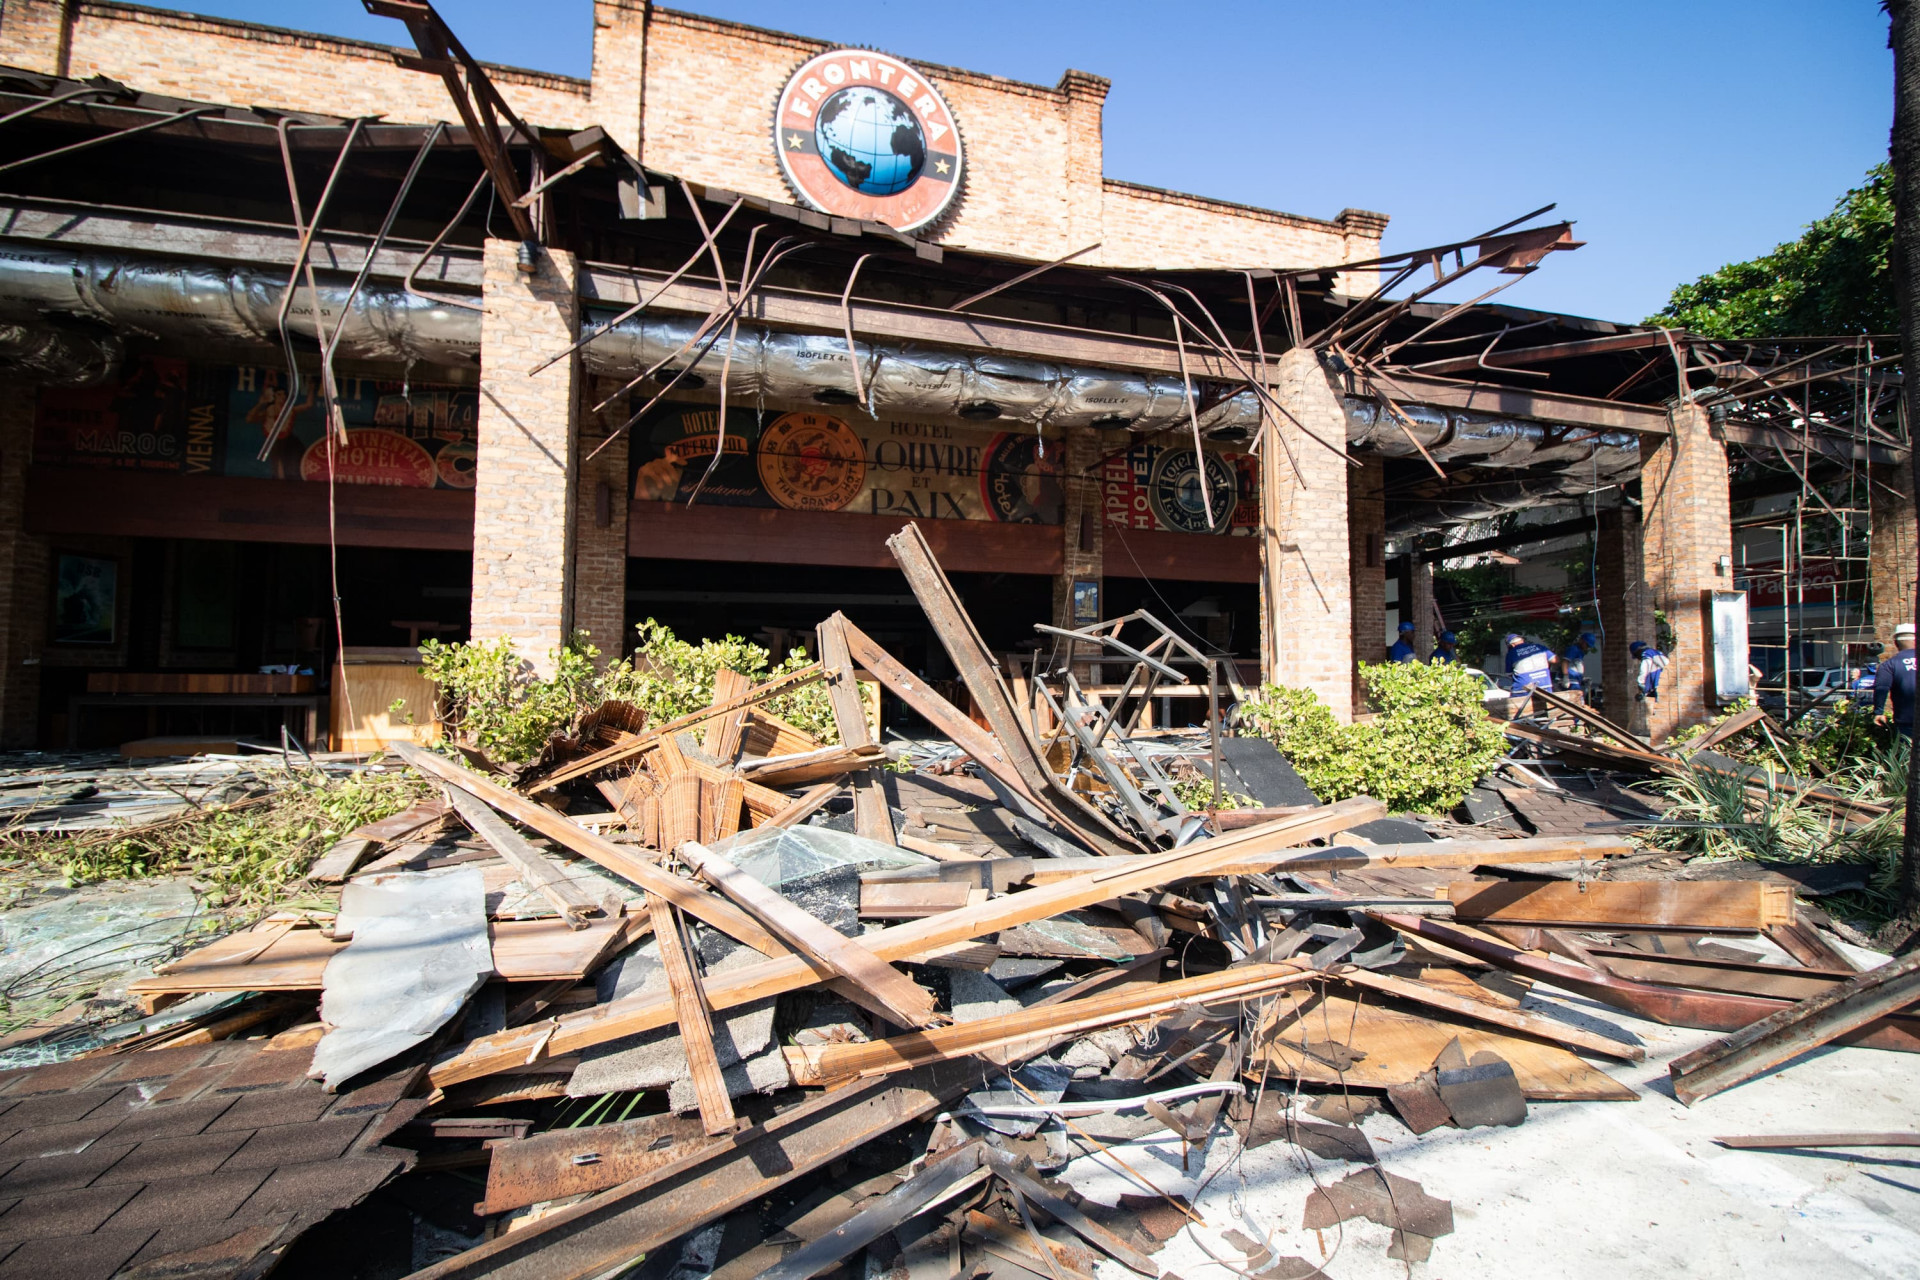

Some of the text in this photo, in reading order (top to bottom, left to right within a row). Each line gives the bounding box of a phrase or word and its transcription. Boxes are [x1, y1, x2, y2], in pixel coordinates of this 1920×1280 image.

[791, 59, 949, 142] FRONTERA
[796, 350, 837, 362] ISOFLEX
[74, 428, 178, 456] MAROC
[185, 403, 216, 476] VIENNA
[891, 421, 953, 440] HOTEL
[338, 447, 401, 469] HOTEL
[861, 438, 981, 478] LOUVRE
[1160, 452, 1192, 492] Hotel
[776, 451, 858, 506] THE GRAND HOTEL
[912, 477, 931, 489] ET
[1133, 444, 1149, 529] HOTEL
[870, 488, 967, 521] PAIX
[1161, 496, 1181, 521] Los
[1756, 573, 1836, 596] Pacheco
